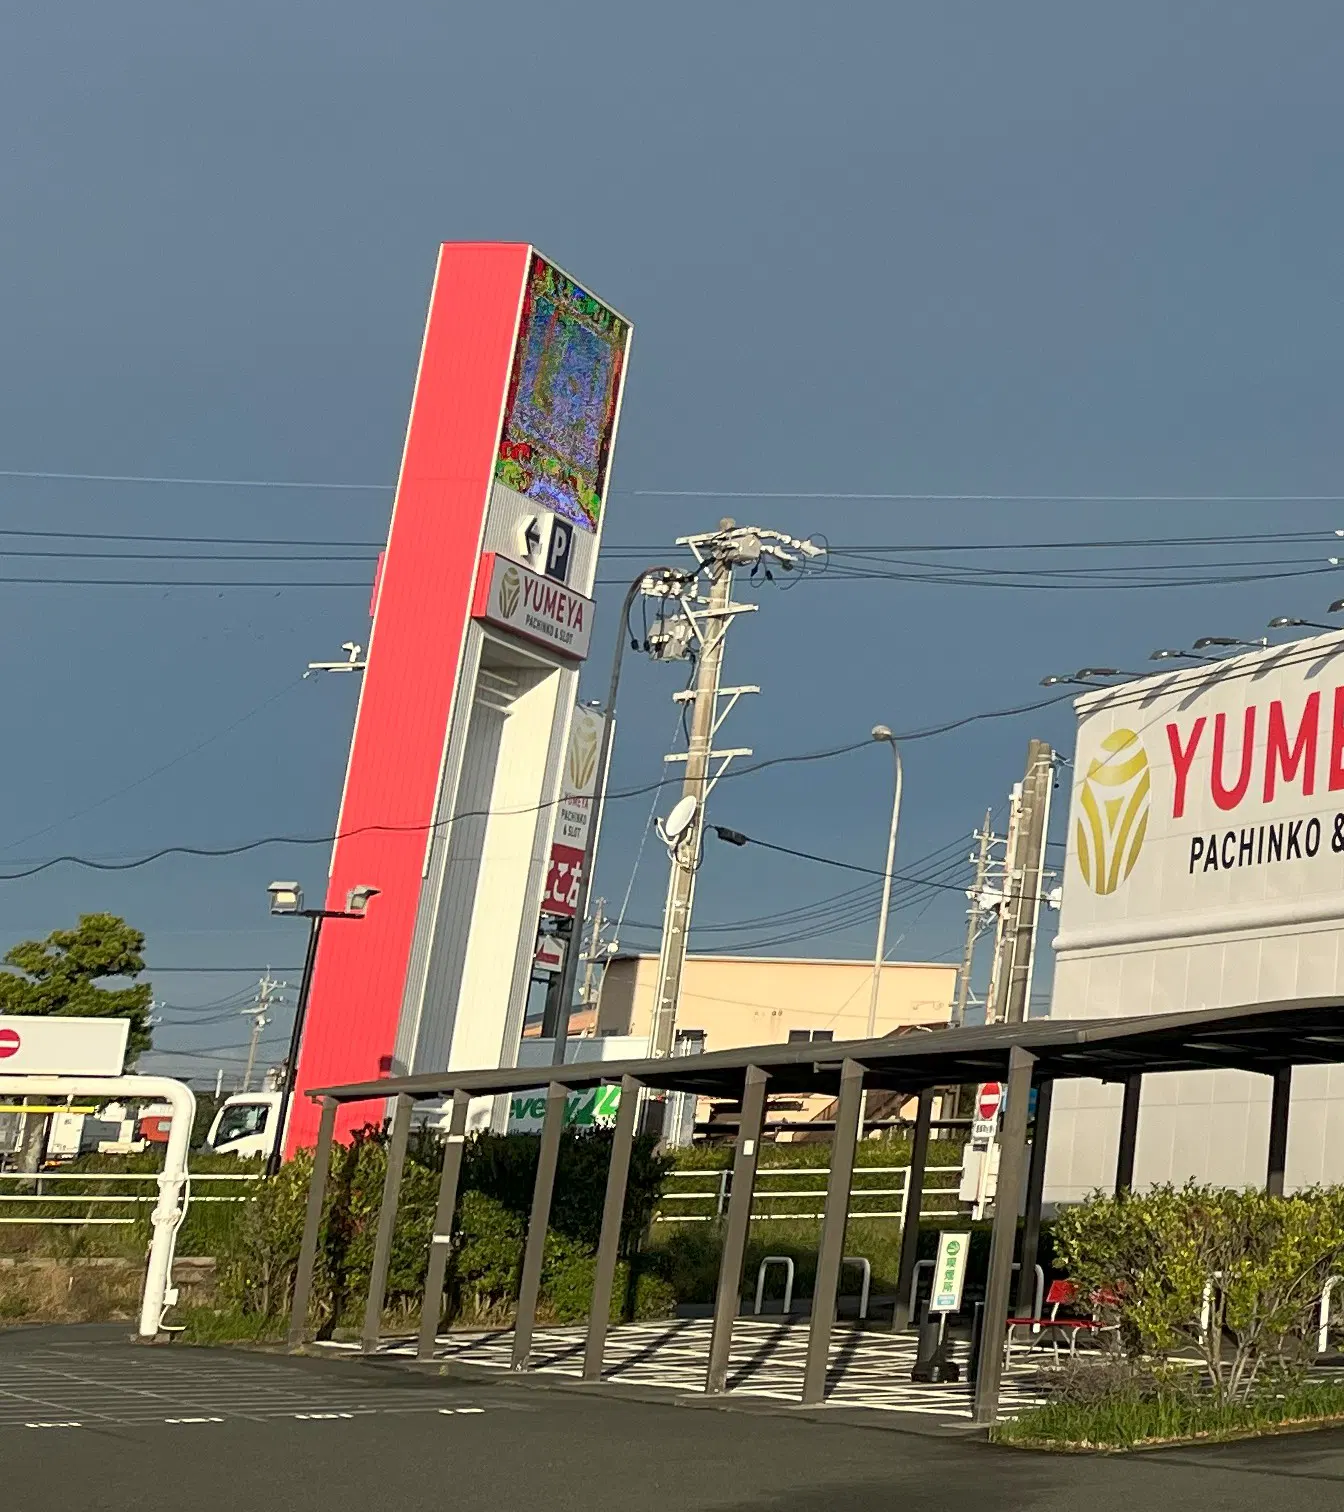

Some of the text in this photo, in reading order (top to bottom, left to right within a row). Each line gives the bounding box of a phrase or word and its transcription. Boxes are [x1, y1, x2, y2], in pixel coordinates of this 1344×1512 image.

[550, 526, 567, 569] P
[523, 575, 583, 632] YUMEYA
[525, 614, 554, 637] PACHINKO
[560, 631, 574, 645] SLOT
[567, 825, 581, 838] SLOT
[1189, 816, 1321, 874] PACHINKO
